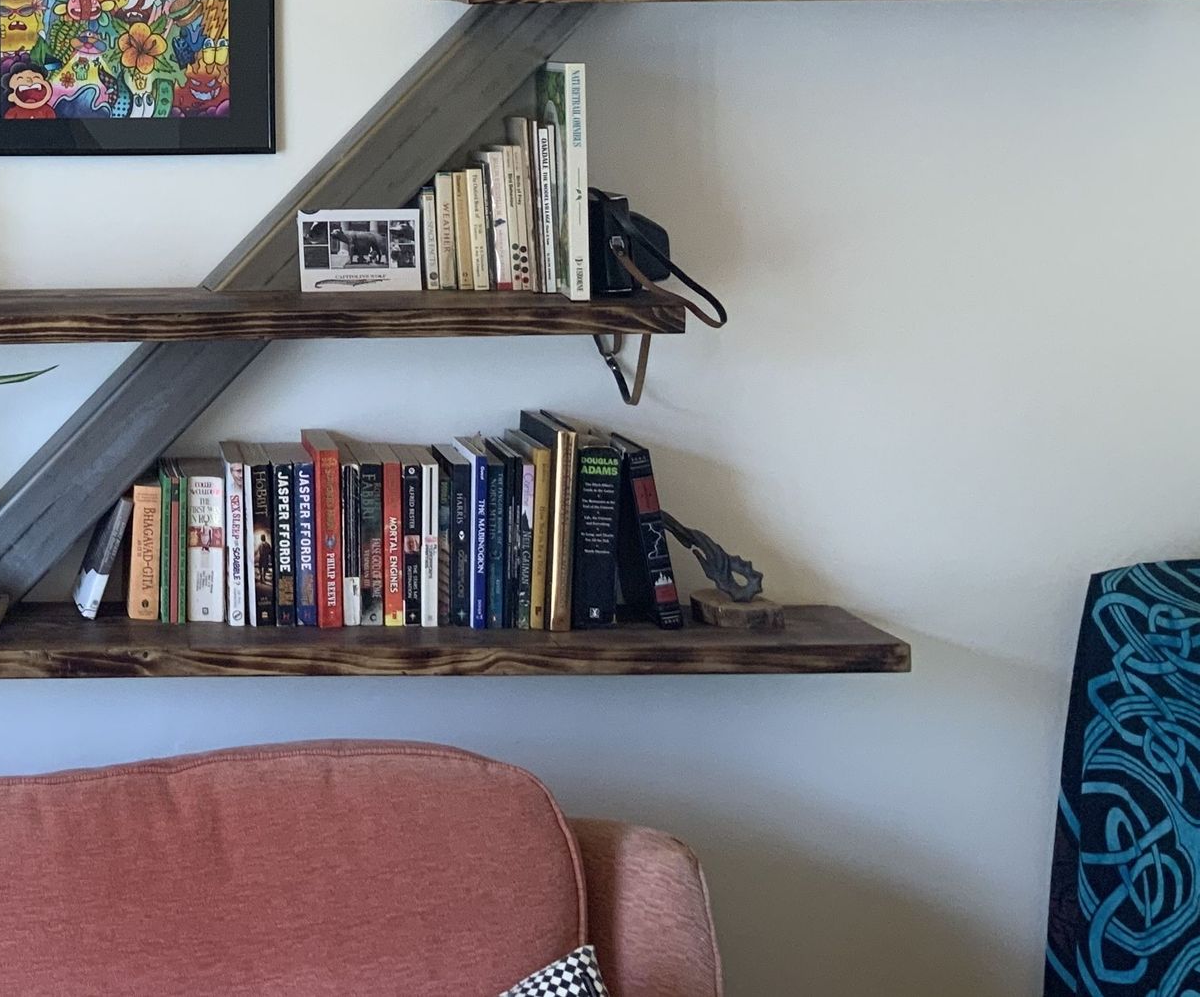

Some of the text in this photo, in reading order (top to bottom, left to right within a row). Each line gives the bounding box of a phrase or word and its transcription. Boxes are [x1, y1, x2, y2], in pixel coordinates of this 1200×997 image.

[570, 70, 581, 147] NATURETRAIL OMNIBUS
[441, 203, 451, 252] WEATHER
[581, 456, 619, 465] DOUGLAS
[581, 465, 618, 475] ADAMS
[298, 470, 309, 517] JASPER
[360, 473, 376, 520] FABBRI
[455, 492, 463, 524] HARRIS
[477, 499, 485, 515] THE
[277, 471, 290, 572] JASPER FFORDE
[476, 518, 484, 573] MABINOGION
[300, 522, 310, 570] FFORDE
[371, 538, 381, 597] FALSE GOD OF ROME
[388, 517, 397, 593] MORTAL ENGINES
[521, 530, 531, 584] NEIL GAIMAN
[326, 552, 335, 606] PHILIP REEVE
[412, 590, 417, 599] MY
